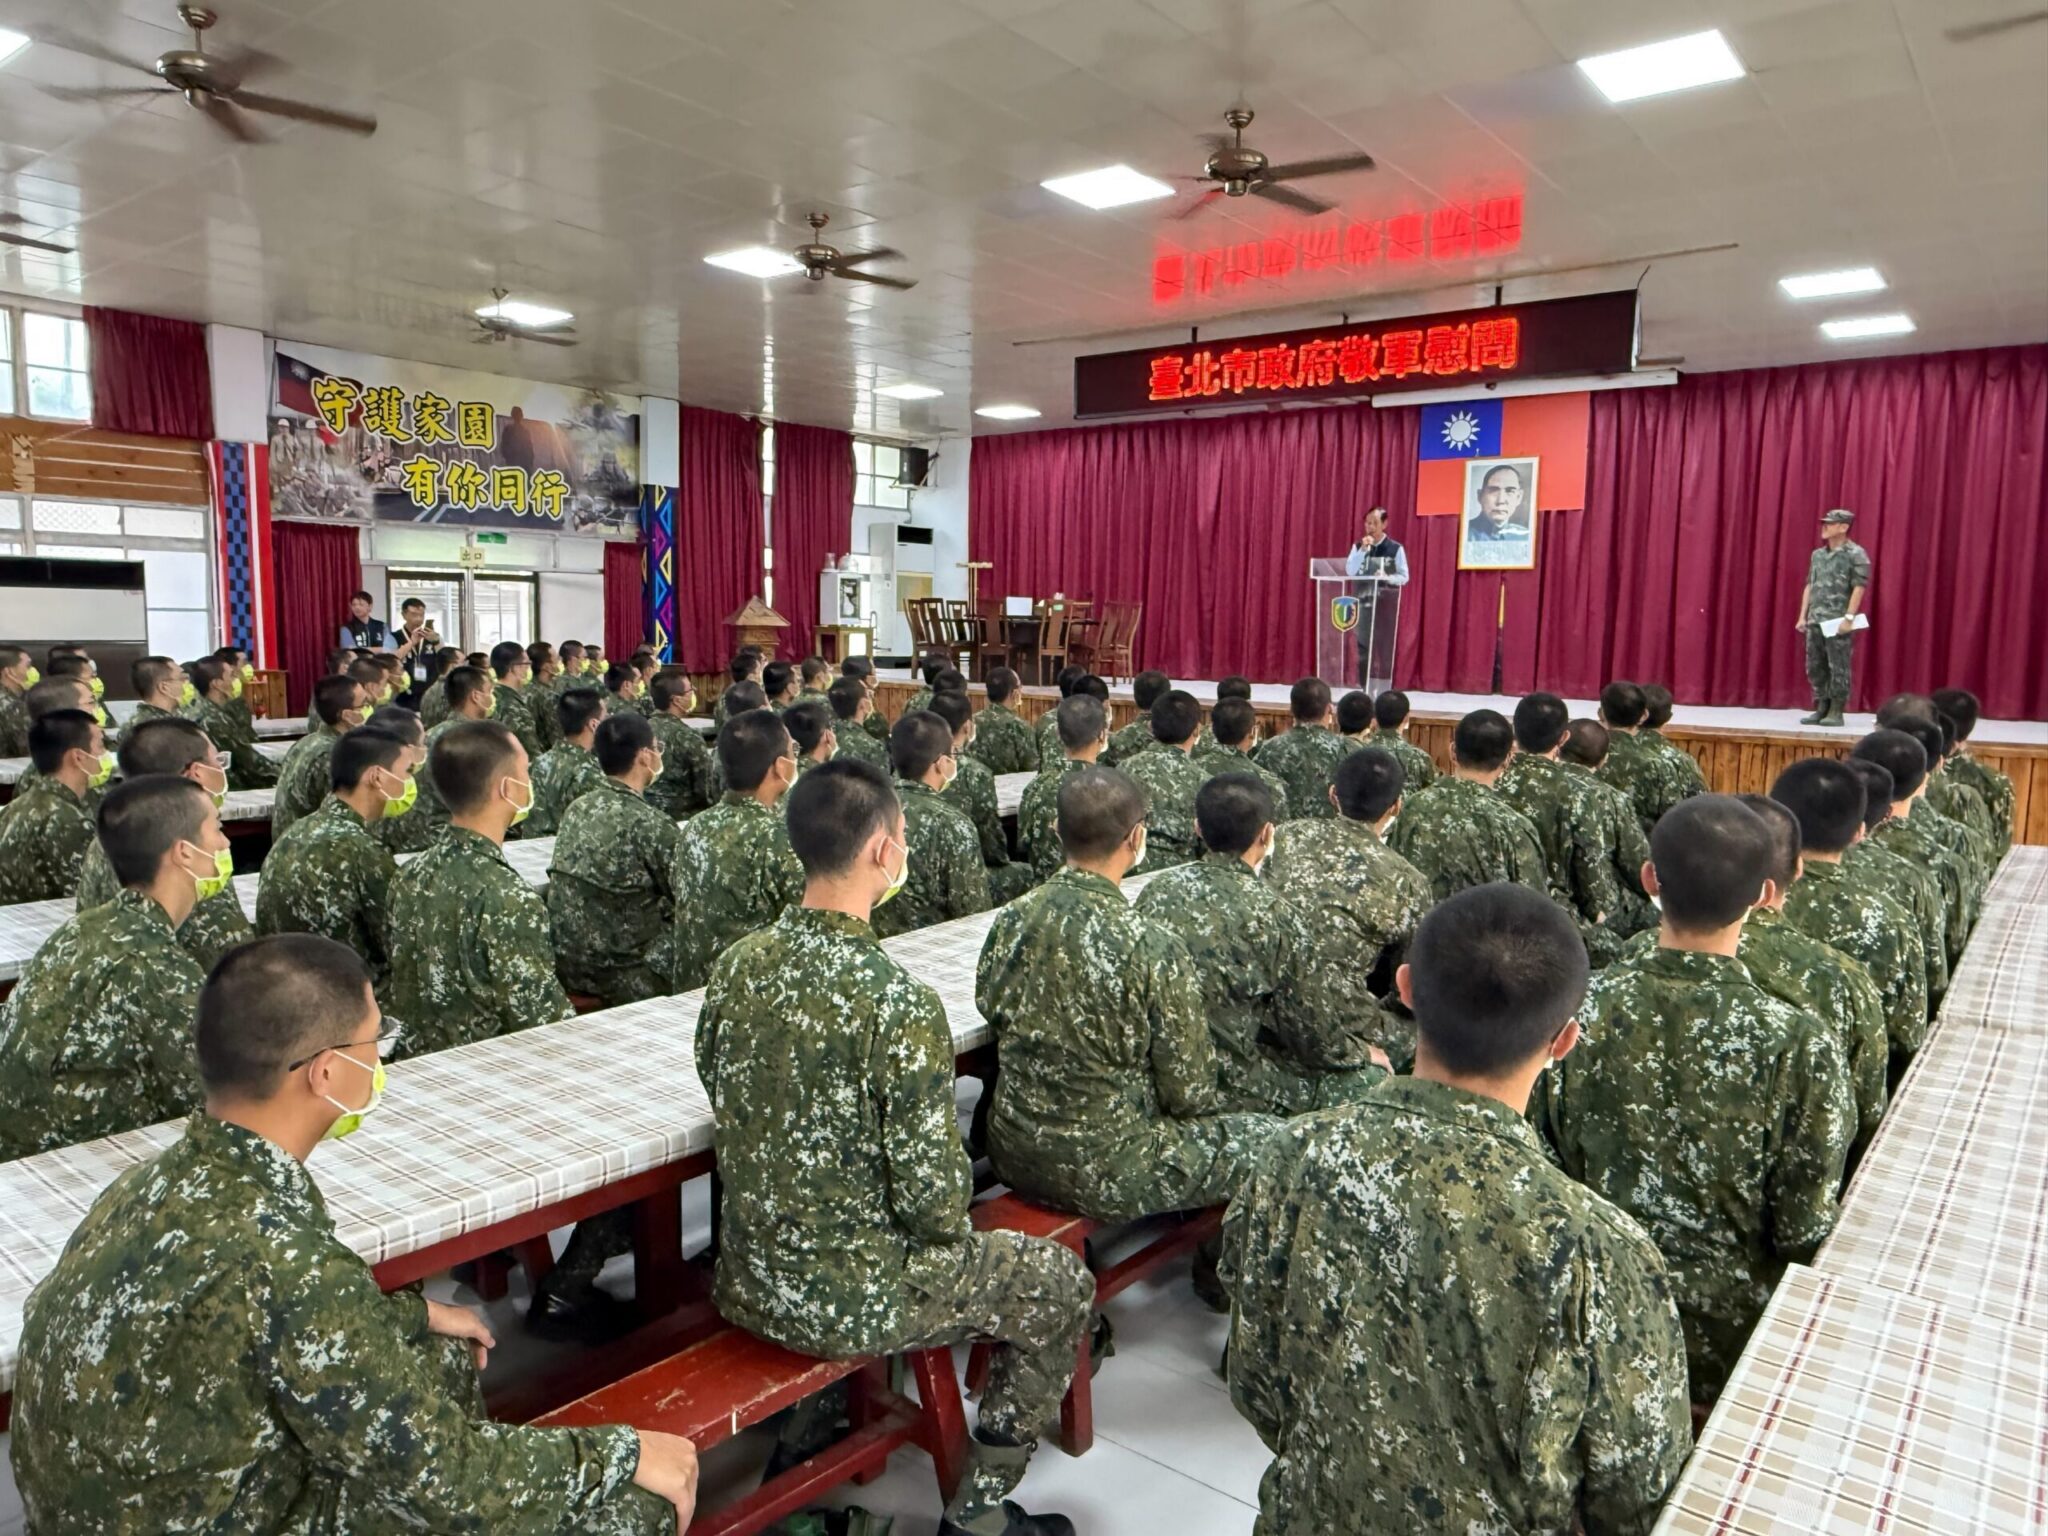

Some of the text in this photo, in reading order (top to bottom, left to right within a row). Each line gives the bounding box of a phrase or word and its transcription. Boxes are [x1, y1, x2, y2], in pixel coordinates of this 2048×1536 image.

[1149, 317, 1518, 400] 臺北市政府敬軍慰問
[312, 376, 497, 451] 守護家園
[402, 454, 570, 519] 有你同行
